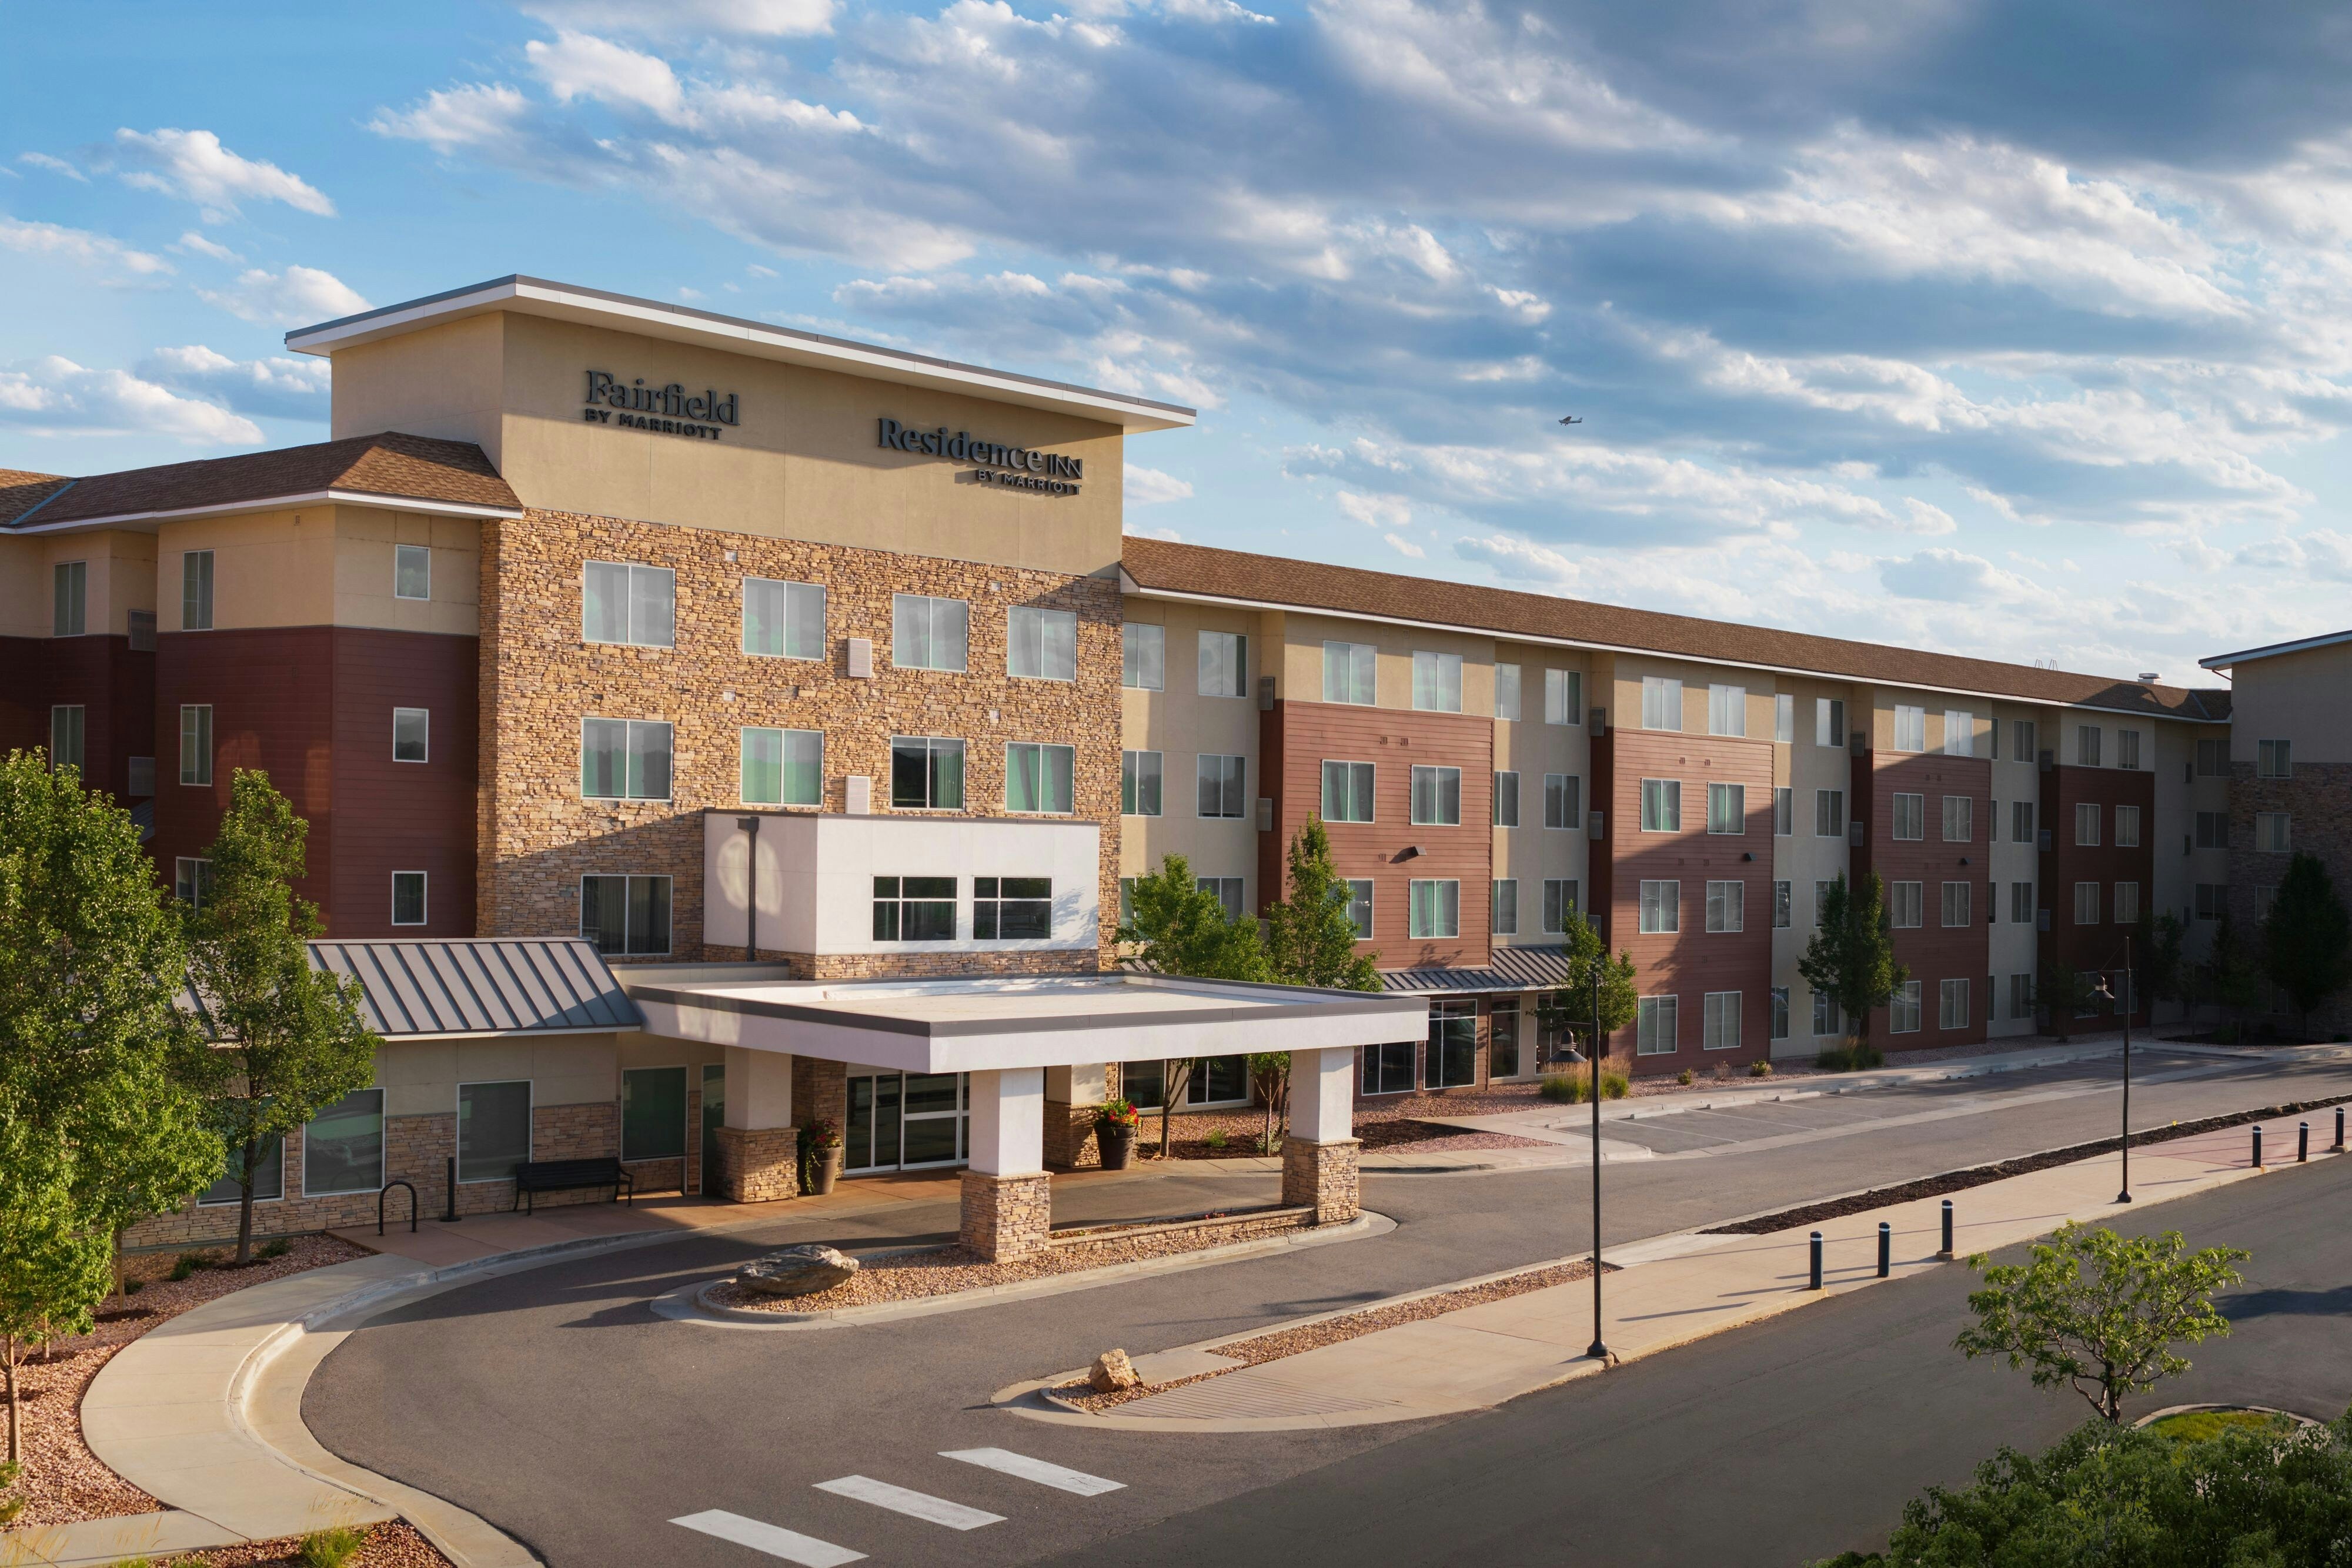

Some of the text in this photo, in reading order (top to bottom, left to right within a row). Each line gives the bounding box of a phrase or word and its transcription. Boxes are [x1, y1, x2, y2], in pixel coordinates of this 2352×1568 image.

[586, 370, 740, 426] Fairfield
[585, 408, 722, 440] BY MARRIOTT
[878, 417, 1083, 480] Residence INN
[975, 469, 1083, 496] BY MARRIOTT
